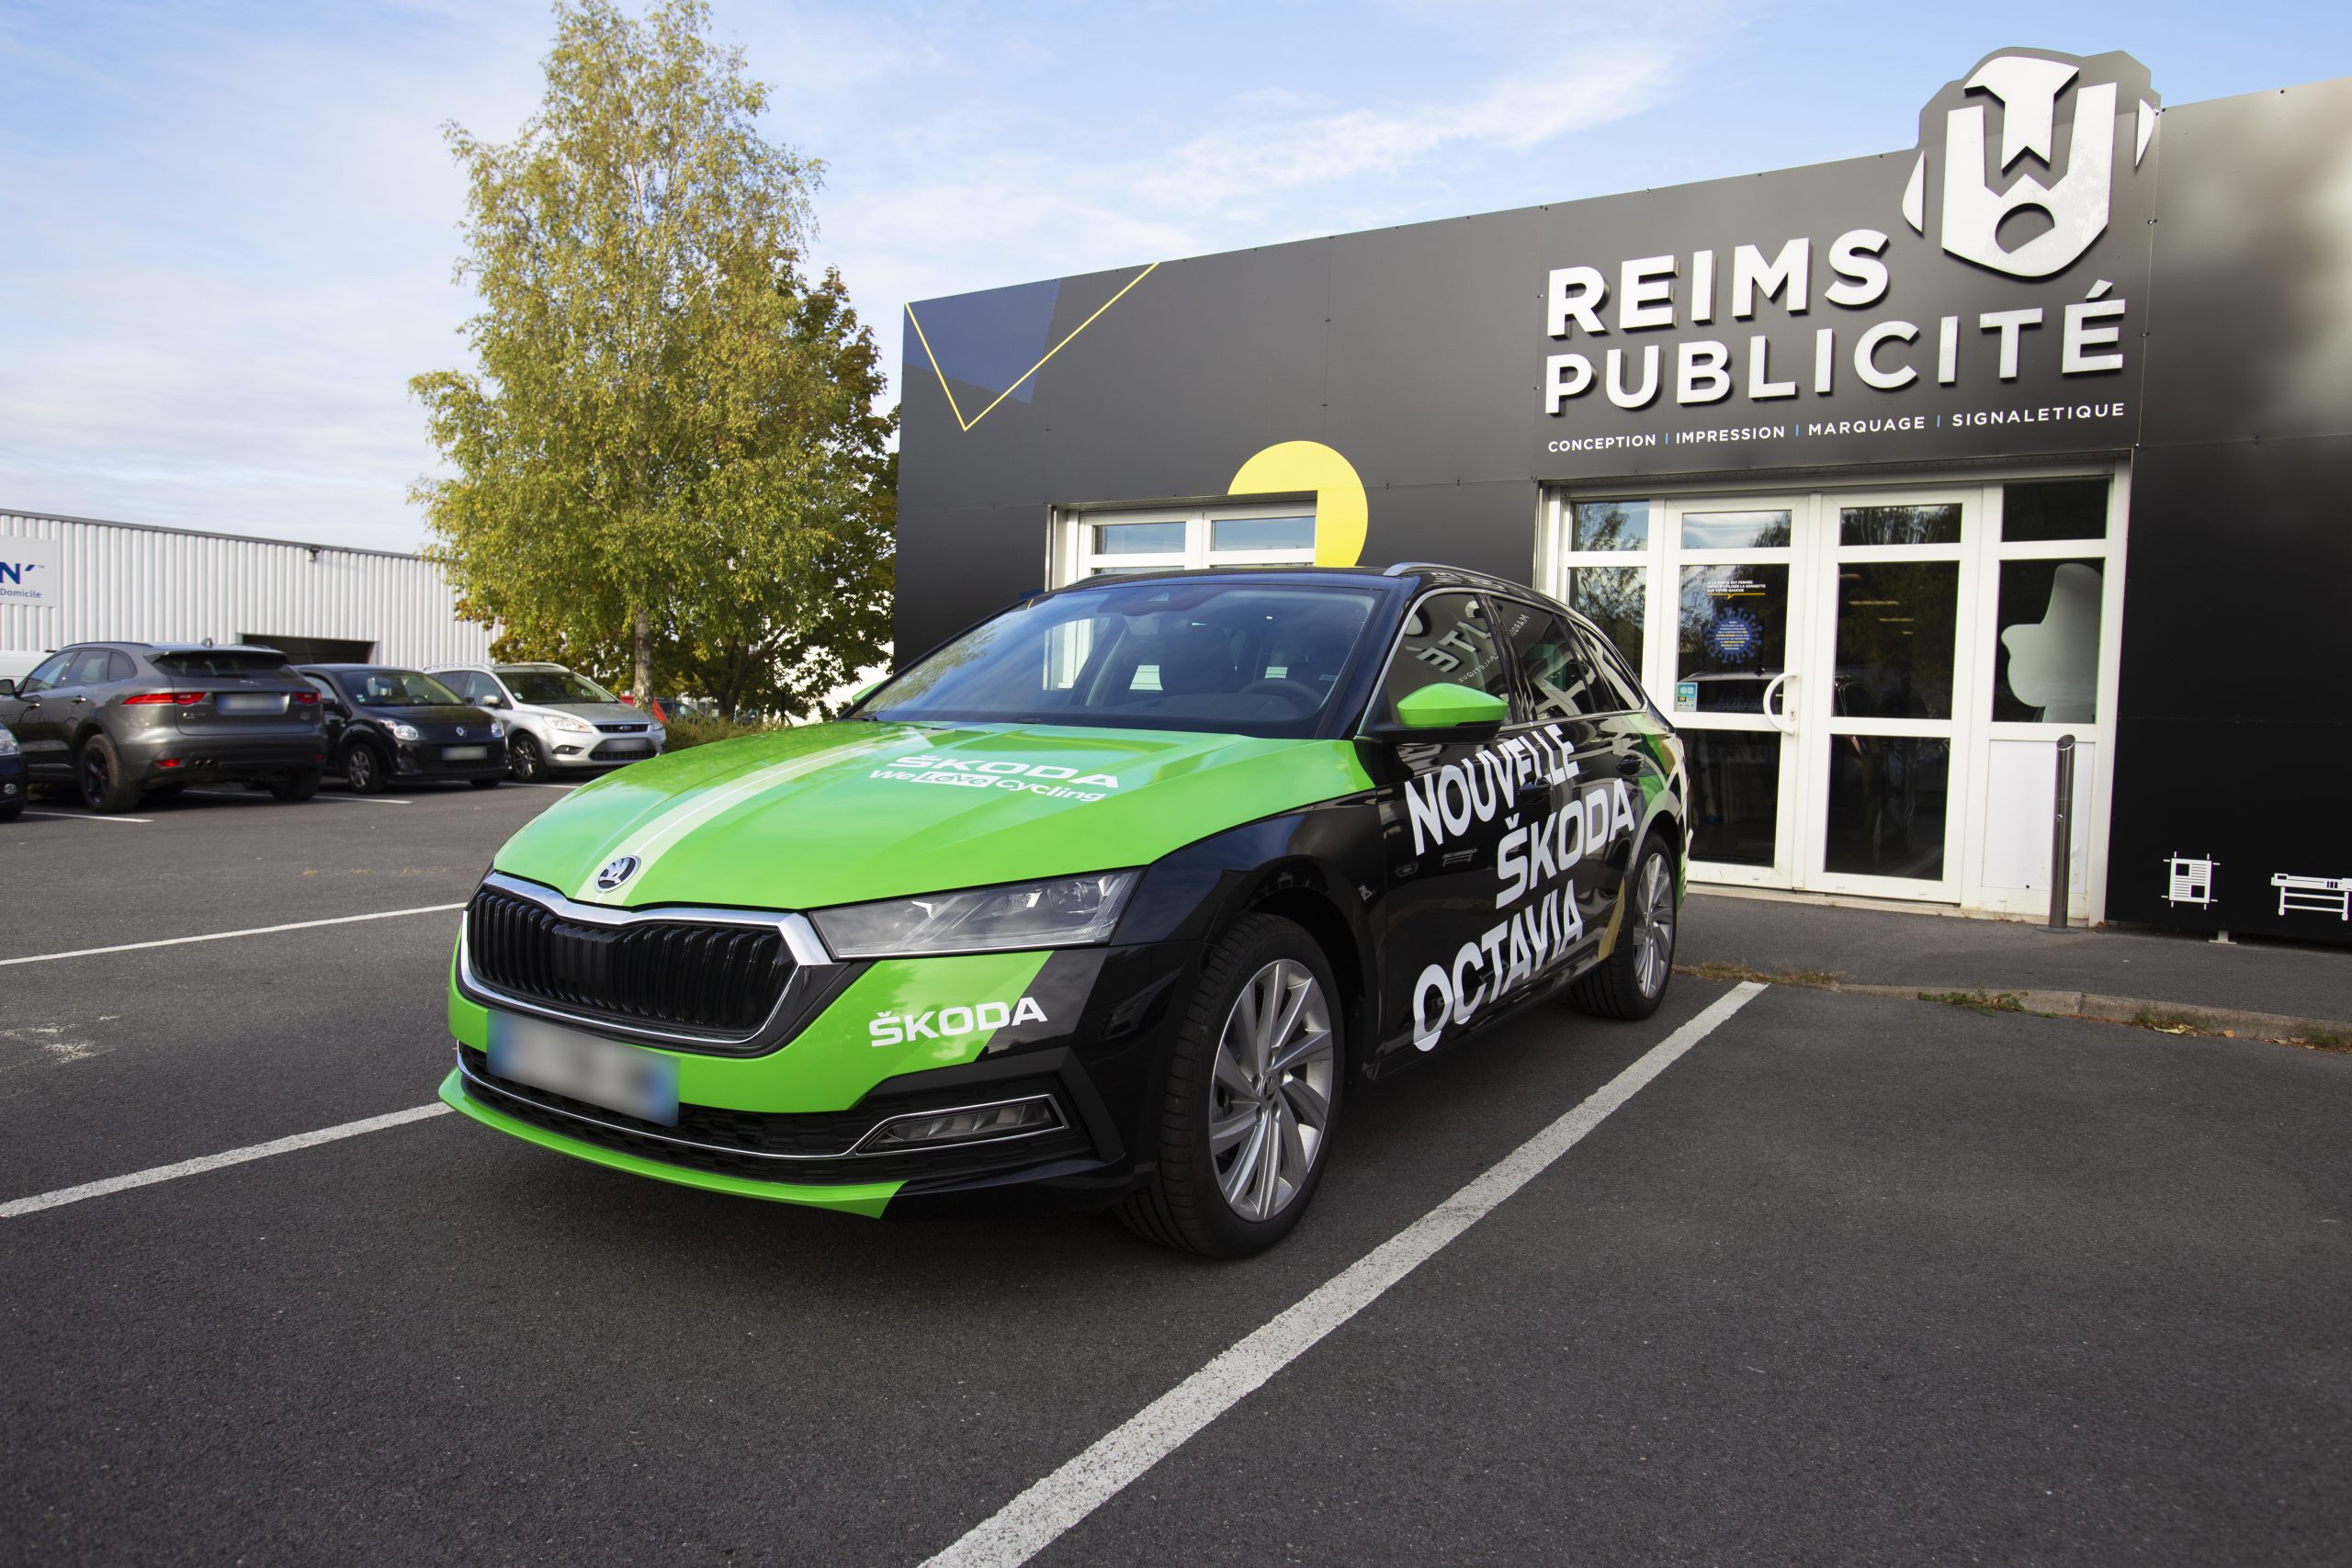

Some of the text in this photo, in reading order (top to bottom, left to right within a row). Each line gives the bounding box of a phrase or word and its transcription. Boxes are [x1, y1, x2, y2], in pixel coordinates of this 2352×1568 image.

[1547, 228, 1890, 338] REIMS
[1545, 279, 2126, 415] PUBLICITÉ
[1548, 402, 2125, 452] CONCEPTION IMPRESSION MARQUAGE SIGNALETIQUE
[0, 588, 42, 599] Domicile
[887, 755, 1120, 788] ŠKODA
[995, 779, 1107, 802] Cycling
[1405, 723, 1580, 857] NOUVELLE
[1496, 778, 1635, 910] ŠKODA
[1413, 879, 1584, 1052] OCTAVIA
[868, 997, 1048, 1047] ŠKODA
